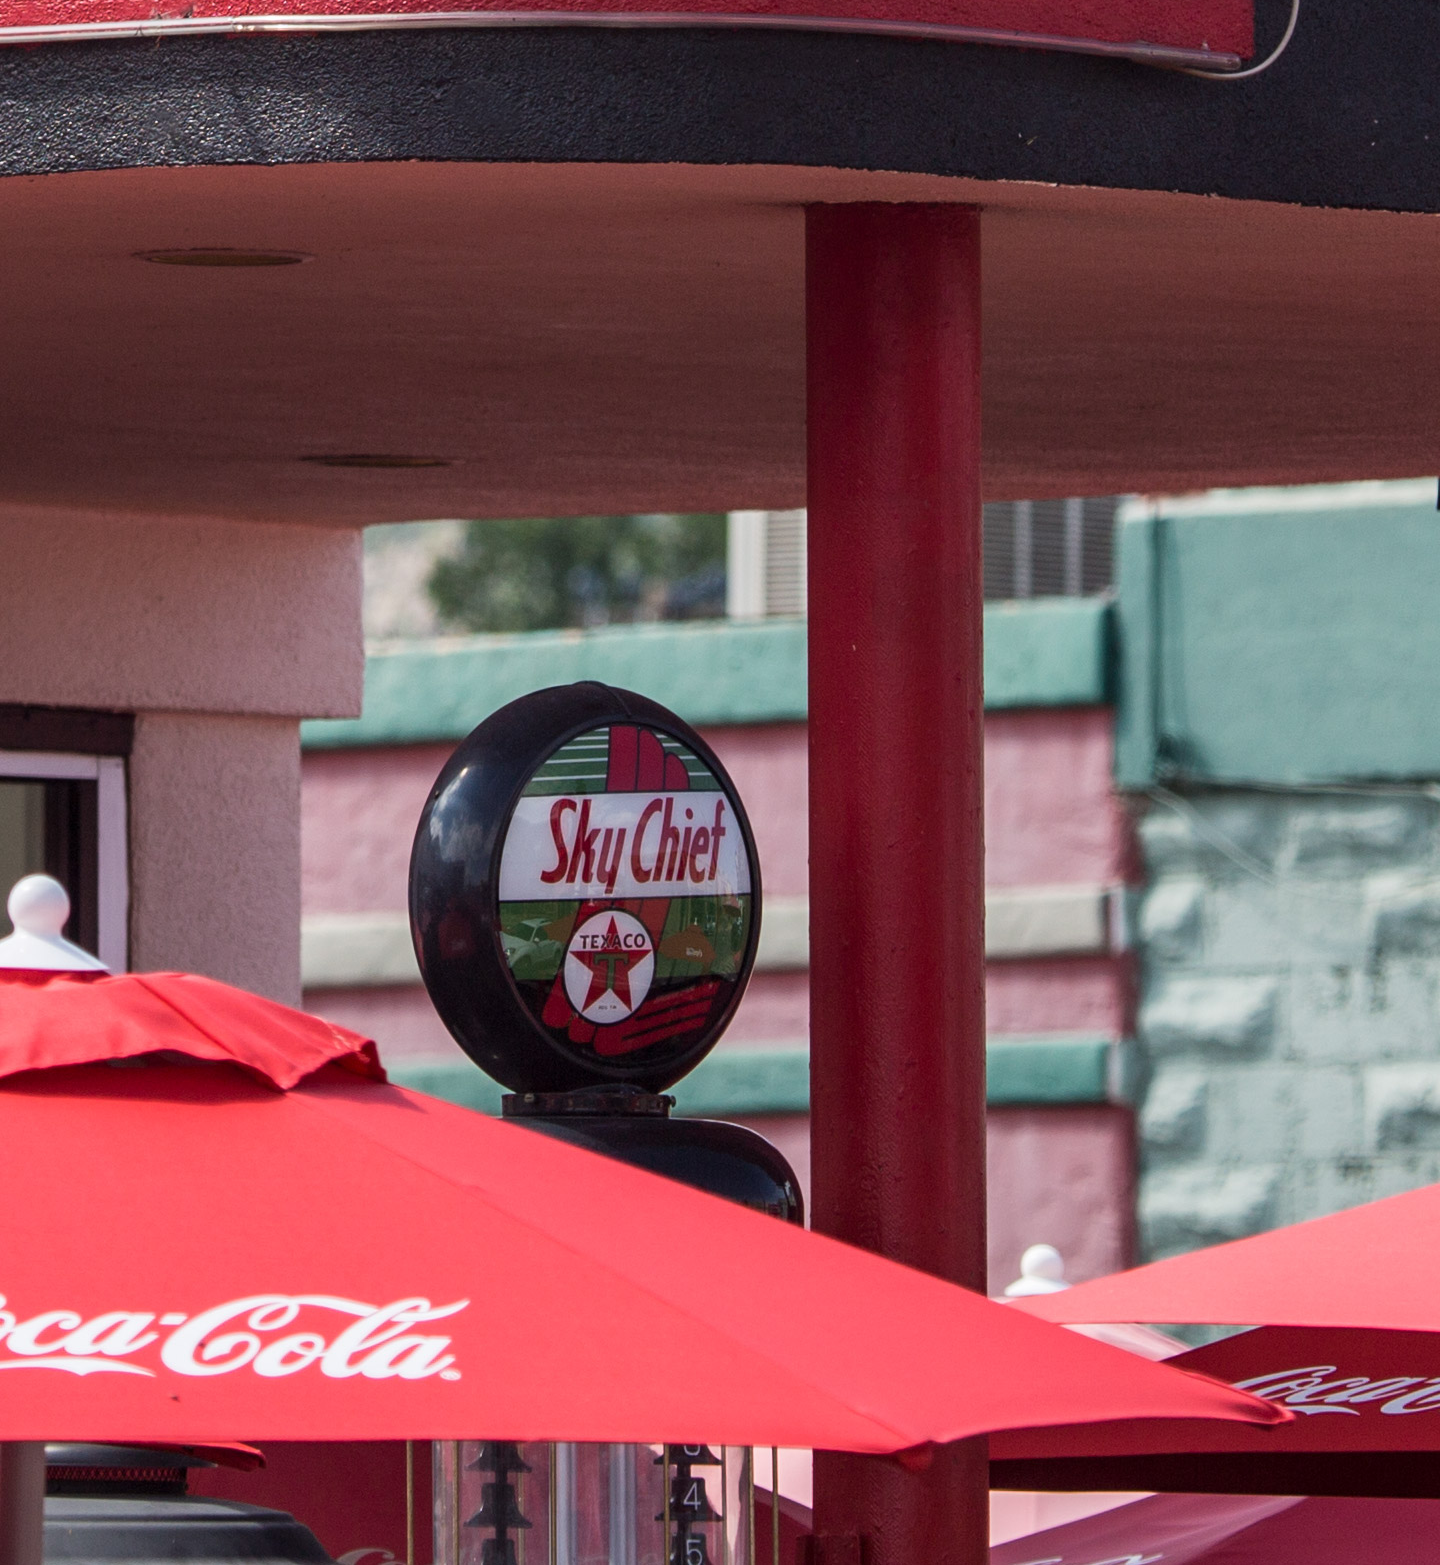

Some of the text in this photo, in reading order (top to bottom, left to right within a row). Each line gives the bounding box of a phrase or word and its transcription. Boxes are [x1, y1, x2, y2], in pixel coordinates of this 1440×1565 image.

[540, 796, 727, 895] Sky Chief
[579, 933, 646, 950] TEXACO
[682, 1480, 703, 1512] 4
